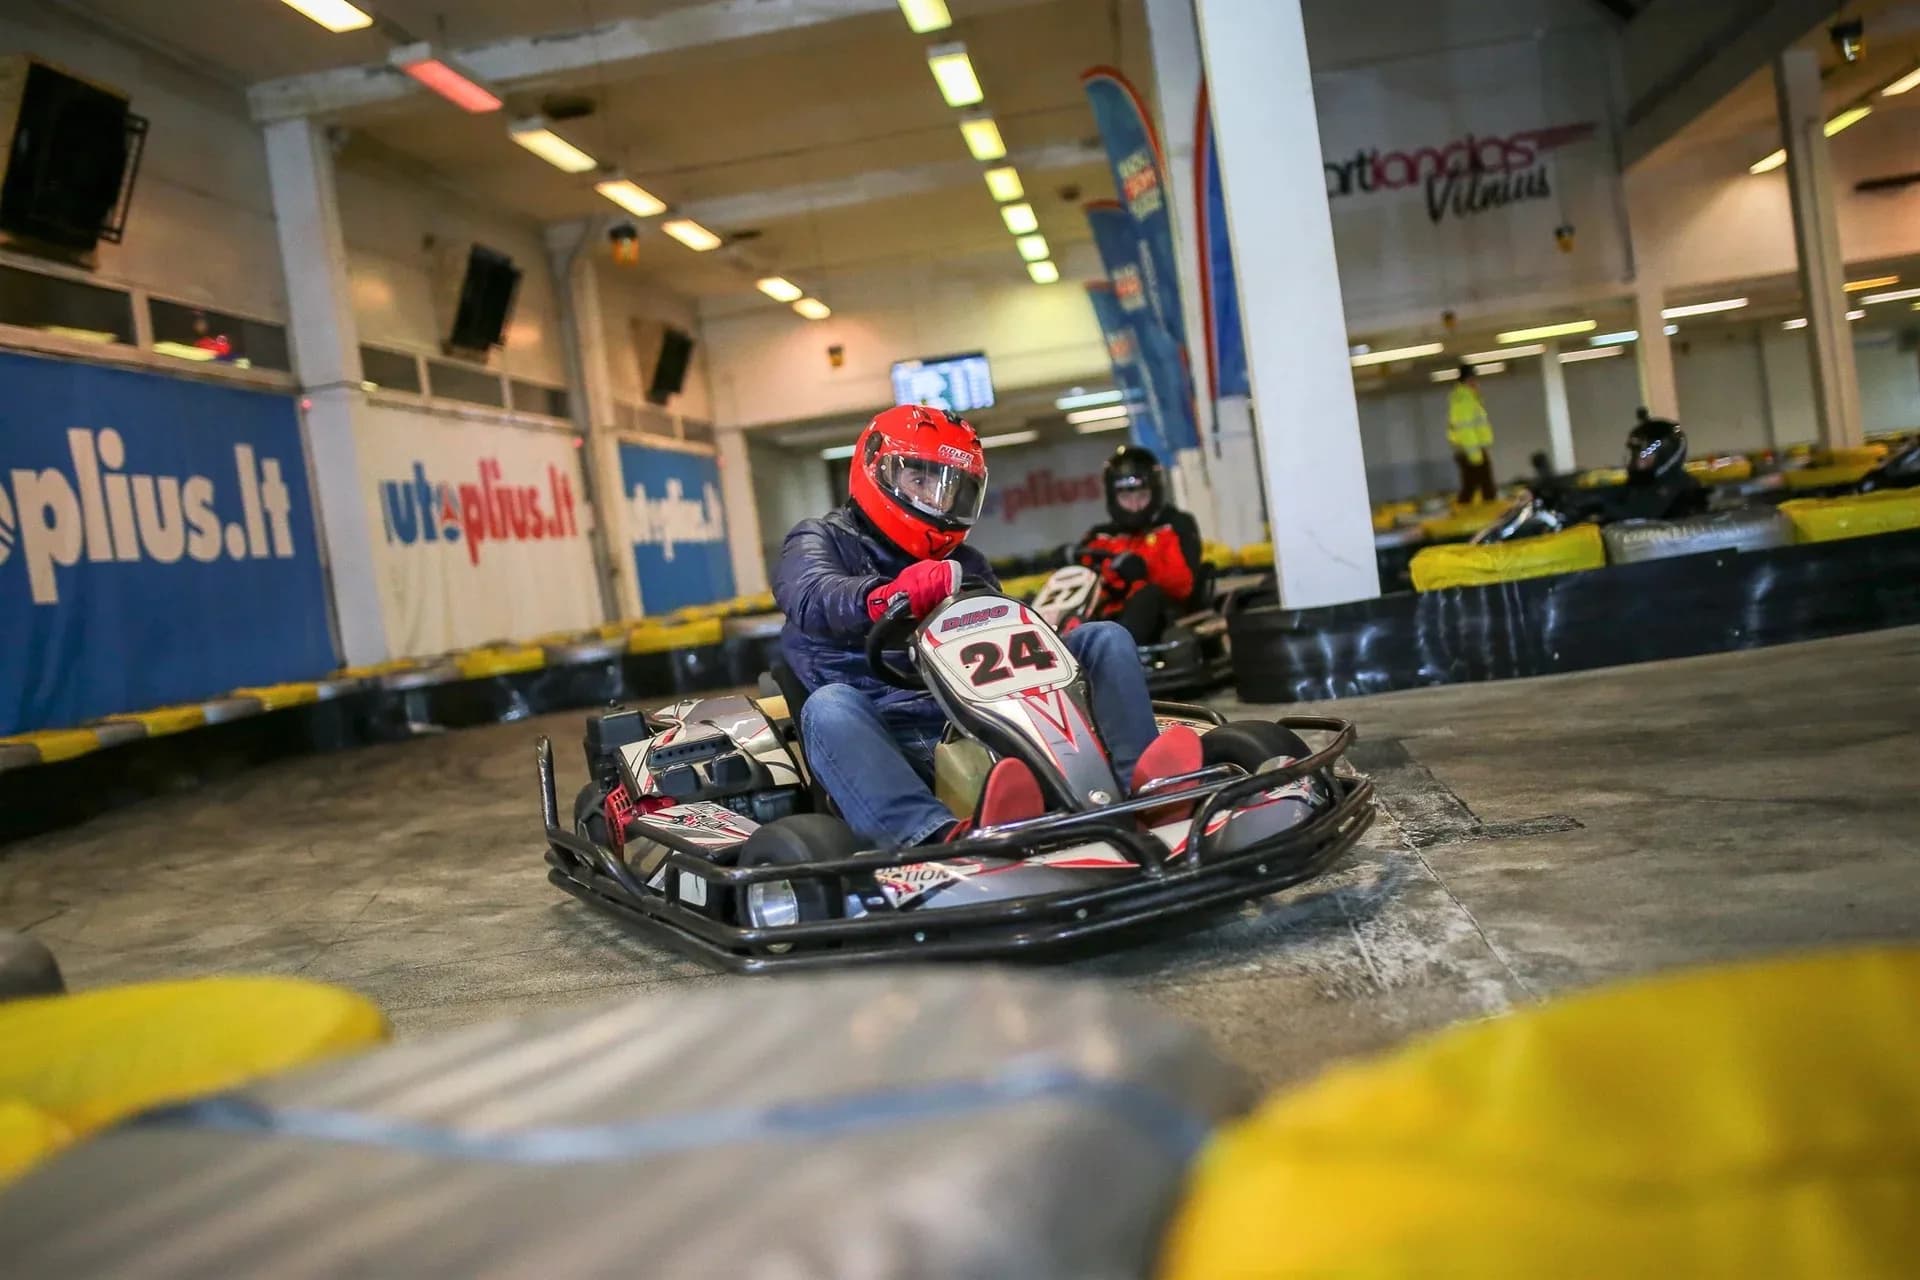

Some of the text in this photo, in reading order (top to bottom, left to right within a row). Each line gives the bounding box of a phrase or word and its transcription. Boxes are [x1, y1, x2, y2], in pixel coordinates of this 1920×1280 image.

[1426, 161, 1551, 224] Vilnius
[379, 459, 578, 567] utoplius.lt
[940, 605, 1009, 632] DINO
[960, 631, 1058, 686] 24
